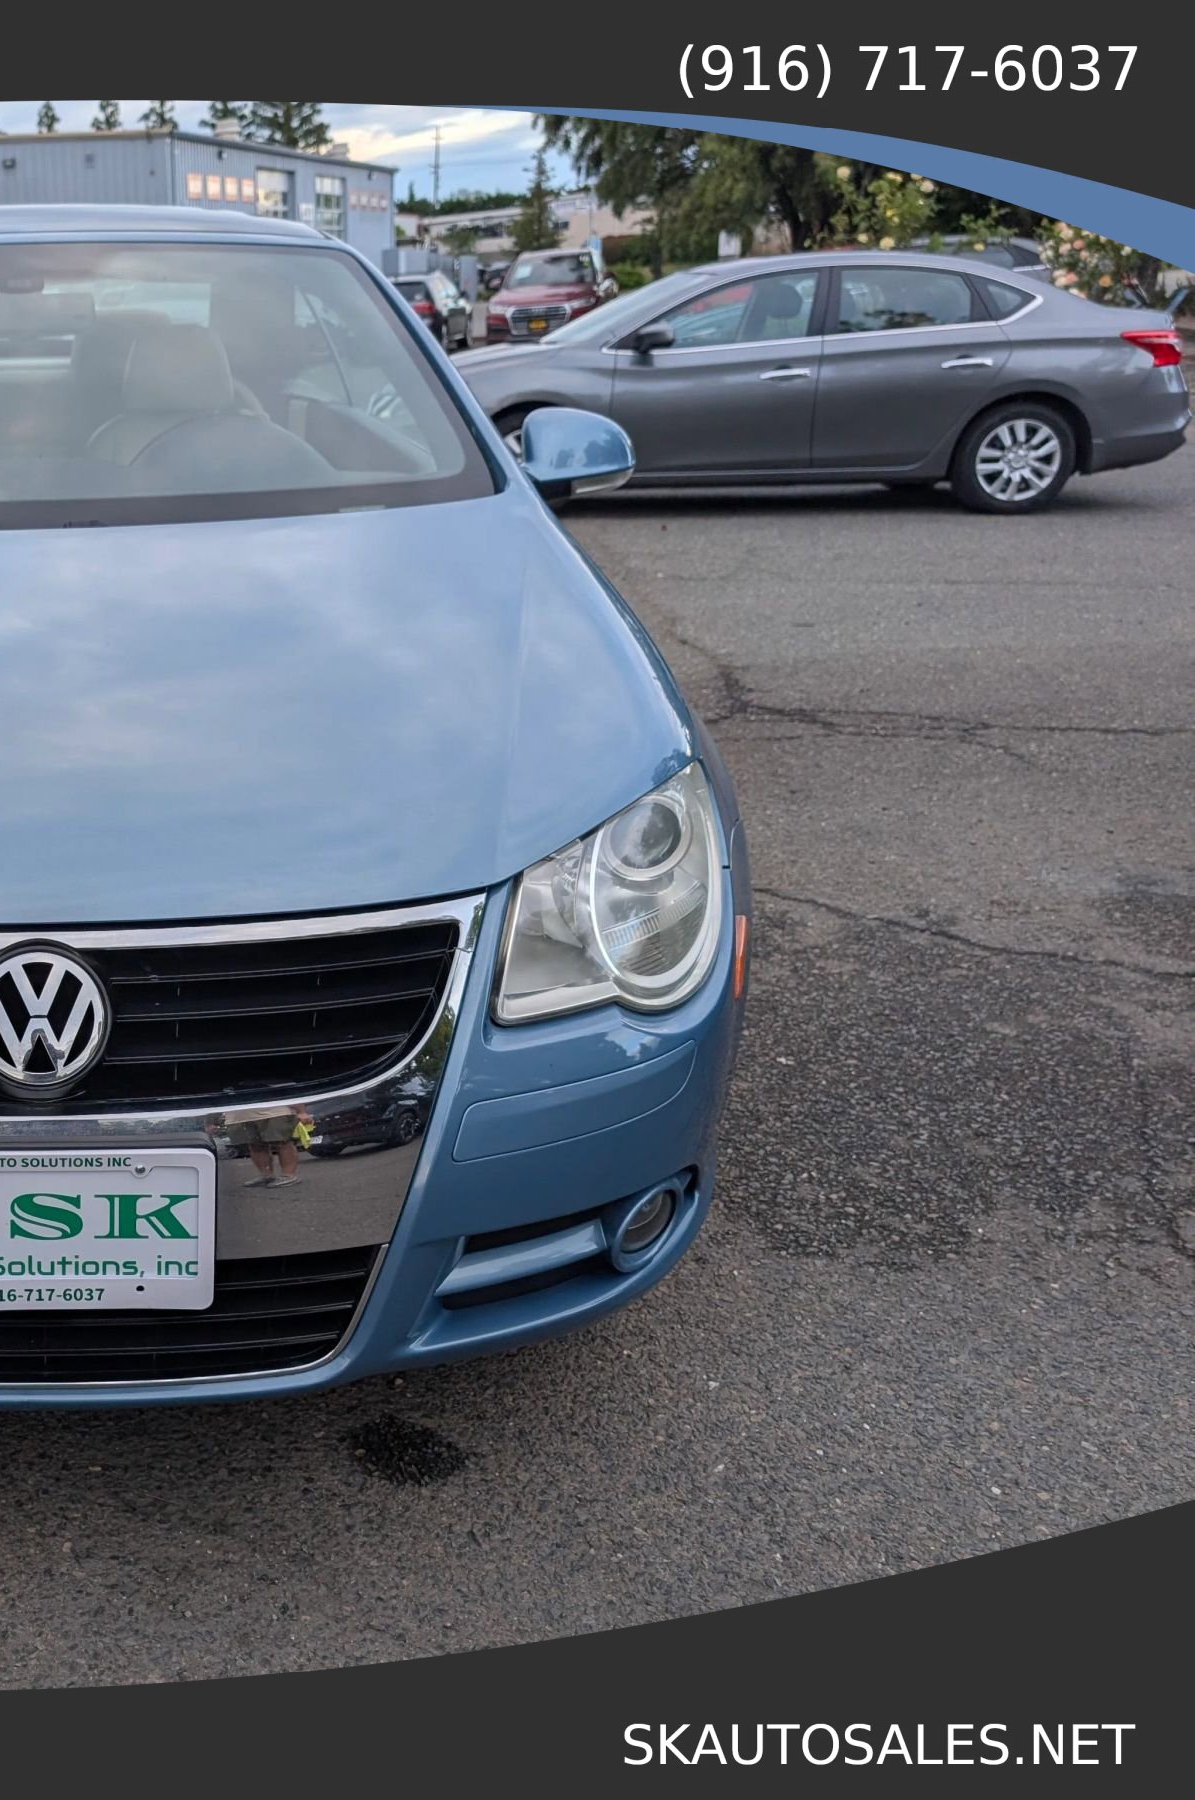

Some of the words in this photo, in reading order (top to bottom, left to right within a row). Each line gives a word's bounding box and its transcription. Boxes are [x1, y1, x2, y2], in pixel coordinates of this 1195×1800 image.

[21, 1156, 104, 1168] SOLUTIONS
[107, 1156, 132, 1168] INC
[9, 1192, 199, 1241] SK
[157, 1254, 199, 1276] inc
